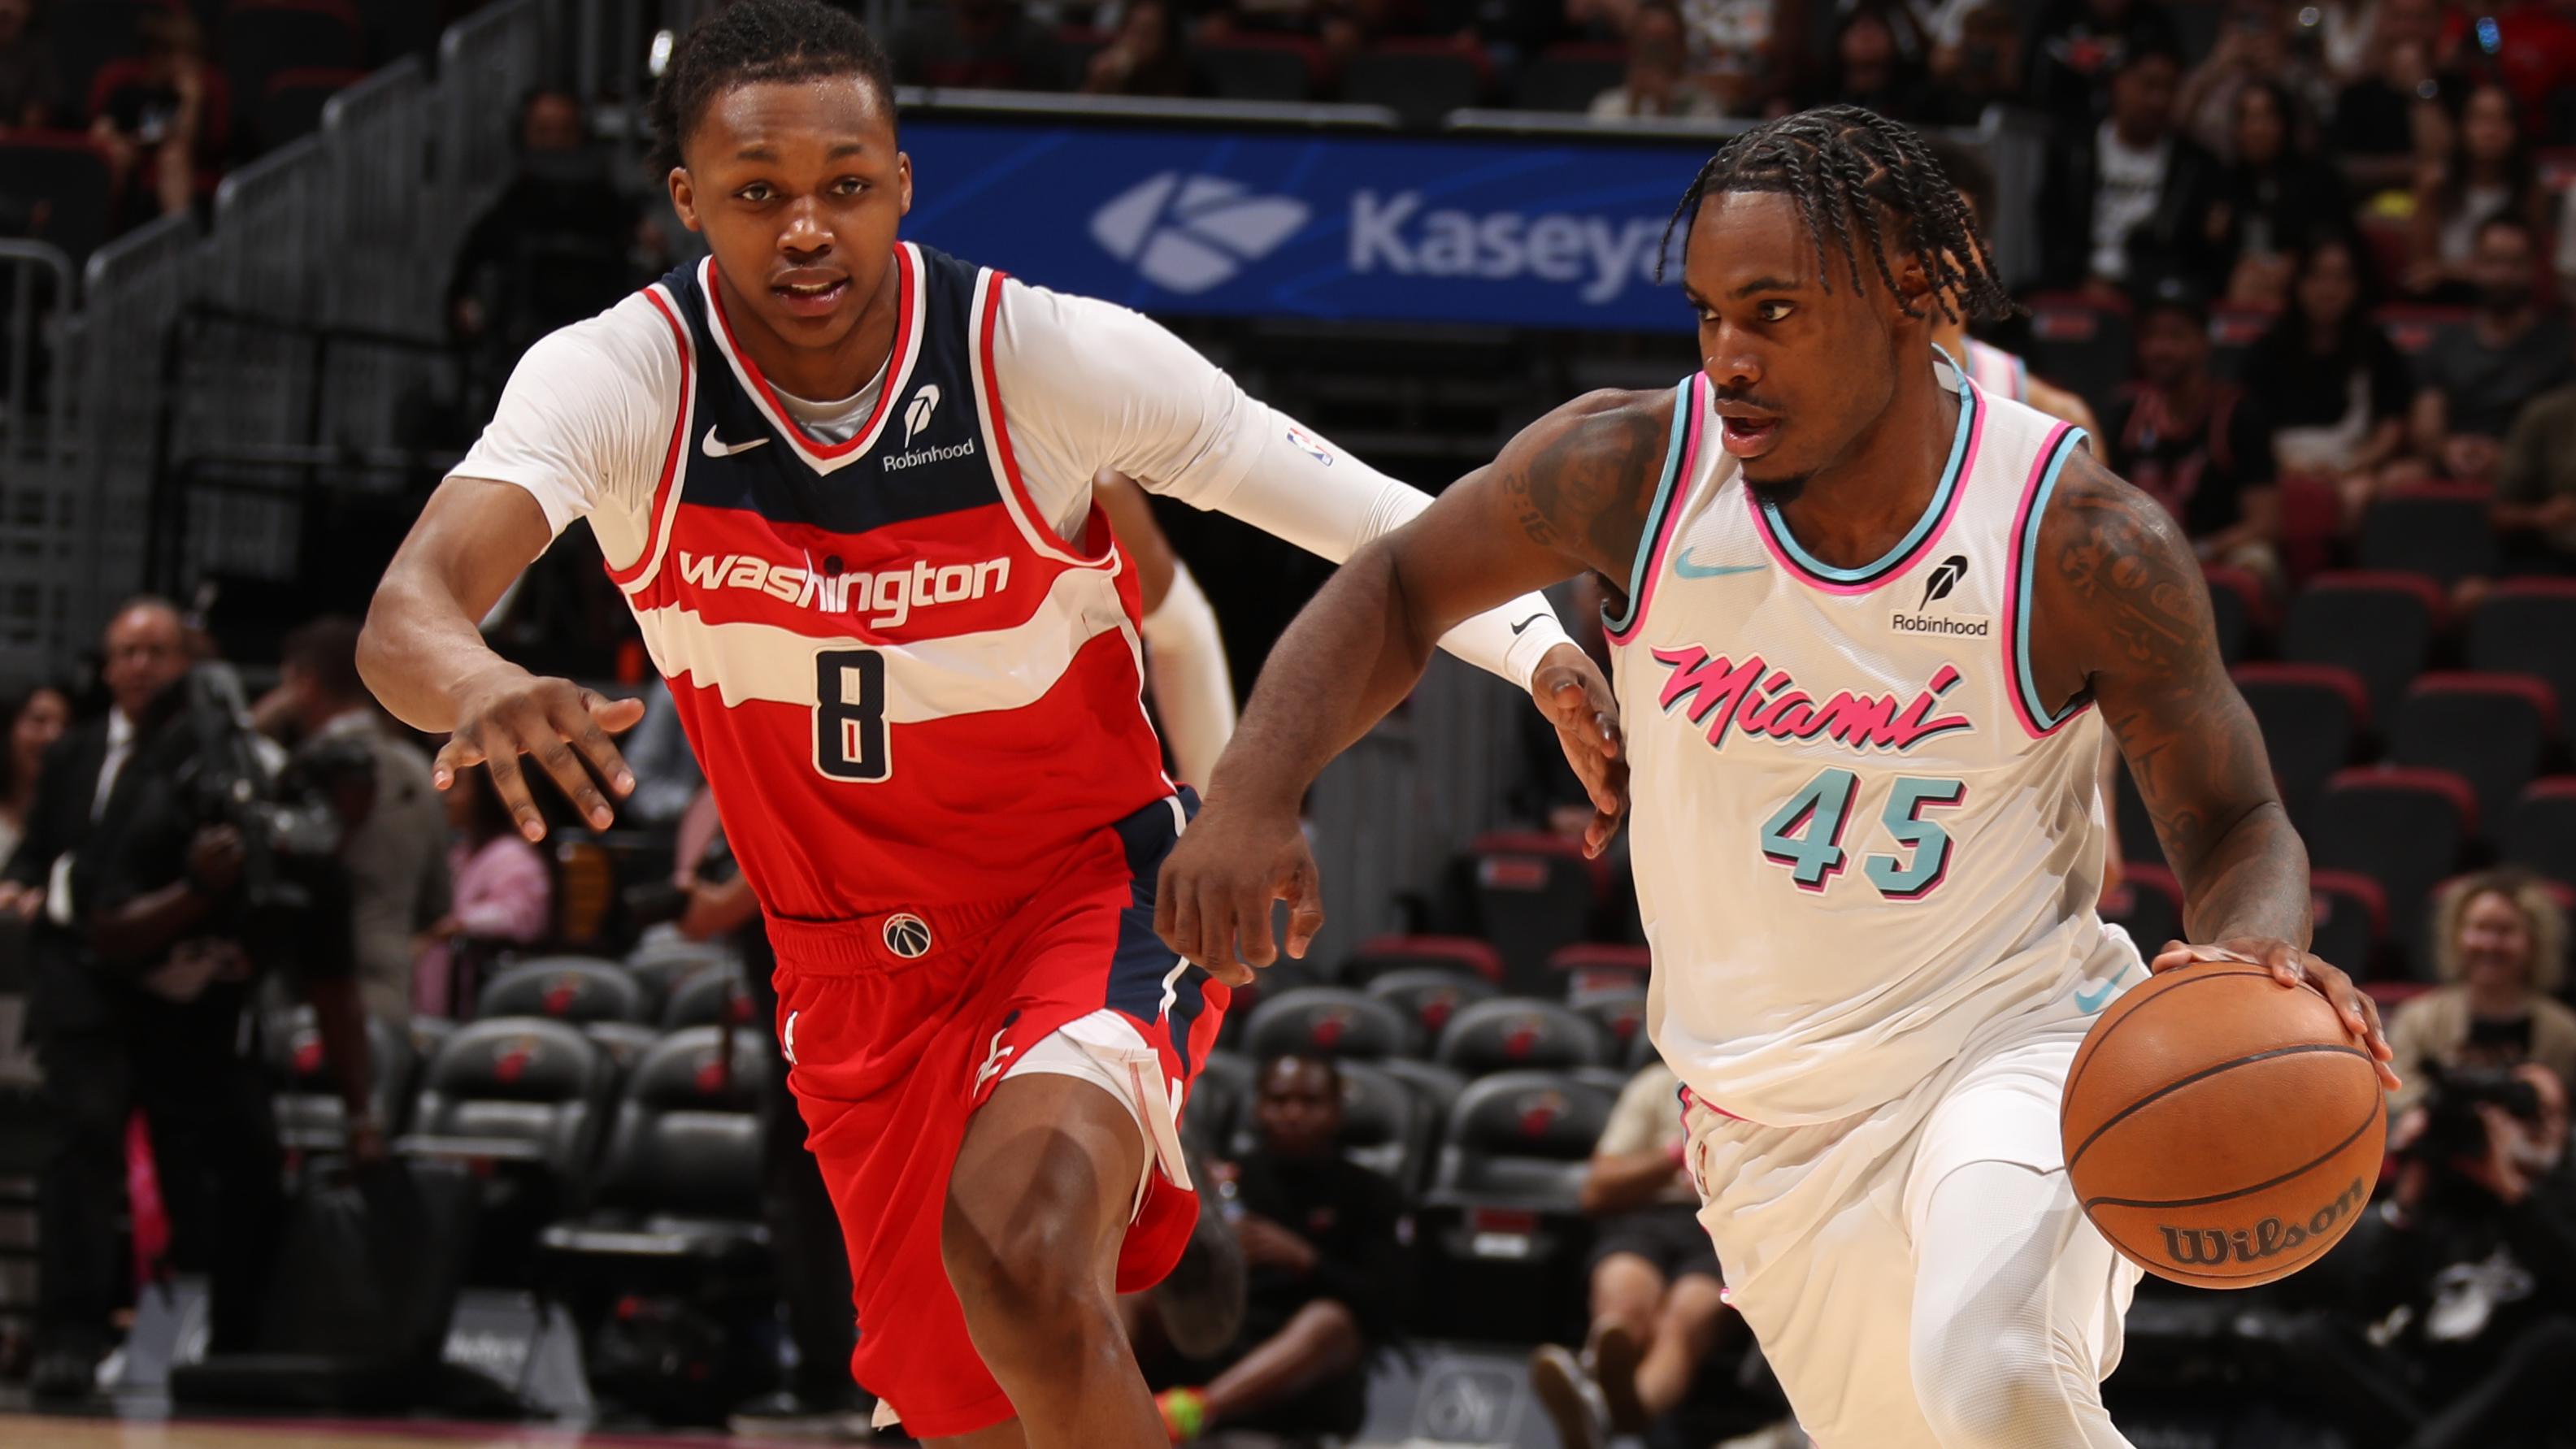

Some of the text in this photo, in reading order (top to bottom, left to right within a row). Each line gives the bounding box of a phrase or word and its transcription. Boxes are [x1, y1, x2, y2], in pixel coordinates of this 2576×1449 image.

[1350, 190, 1687, 303] Kaseya
[883, 437, 975, 472] Robinhood
[1892, 614, 1988, 636] Robinhood
[812, 646, 893, 783] 8
[1650, 645, 1975, 753] Miami
[1760, 765, 1969, 903] 45
[2158, 1175, 2363, 1265] Wilson
